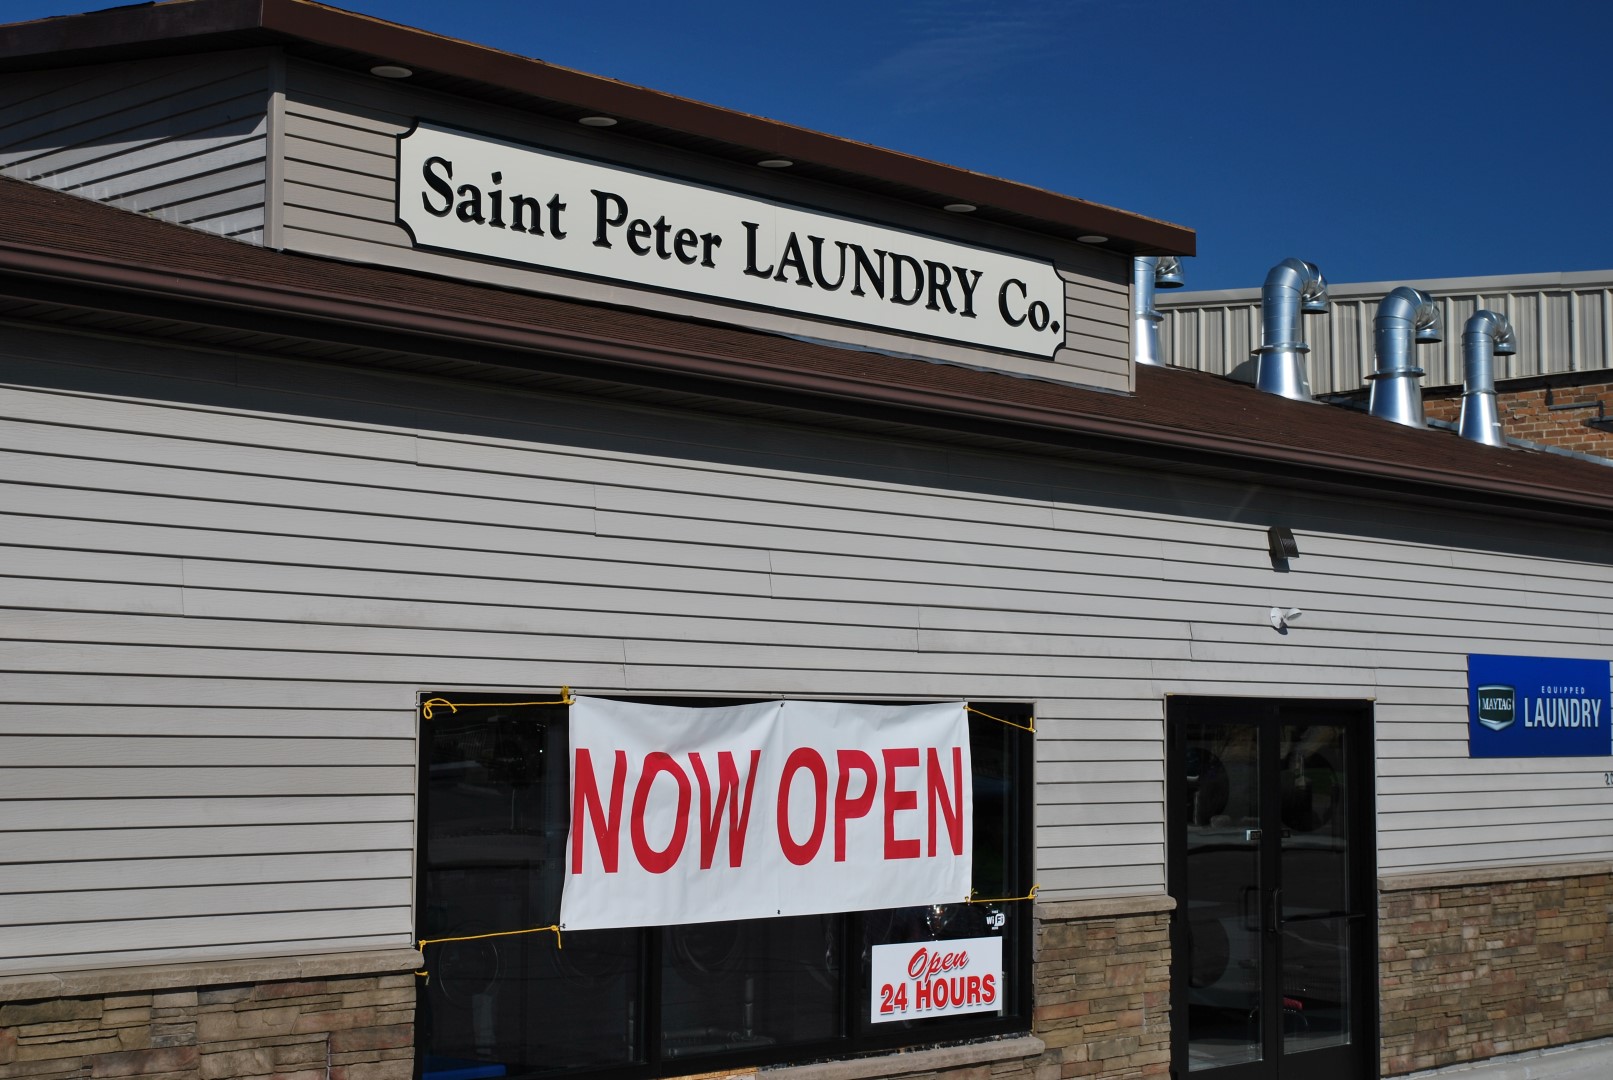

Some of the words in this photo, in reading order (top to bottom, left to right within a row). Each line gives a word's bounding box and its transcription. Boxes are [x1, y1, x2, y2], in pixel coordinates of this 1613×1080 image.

[421, 155, 568, 239] Saint
[590, 188, 722, 269] Peter
[741, 220, 984, 319] LAUNDRY
[998, 277, 1062, 335] Co.
[1482, 698, 1512, 711] MAYTAG
[1541, 685, 1586, 694] EQUIPPED
[1524, 697, 1602, 728] LAUNDRY
[571, 747, 761, 875] NOW
[776, 746, 965, 866] OPEN
[907, 947, 969, 985] Open
[879, 982, 908, 1014] 24
[915, 973, 997, 1011] HOURS
